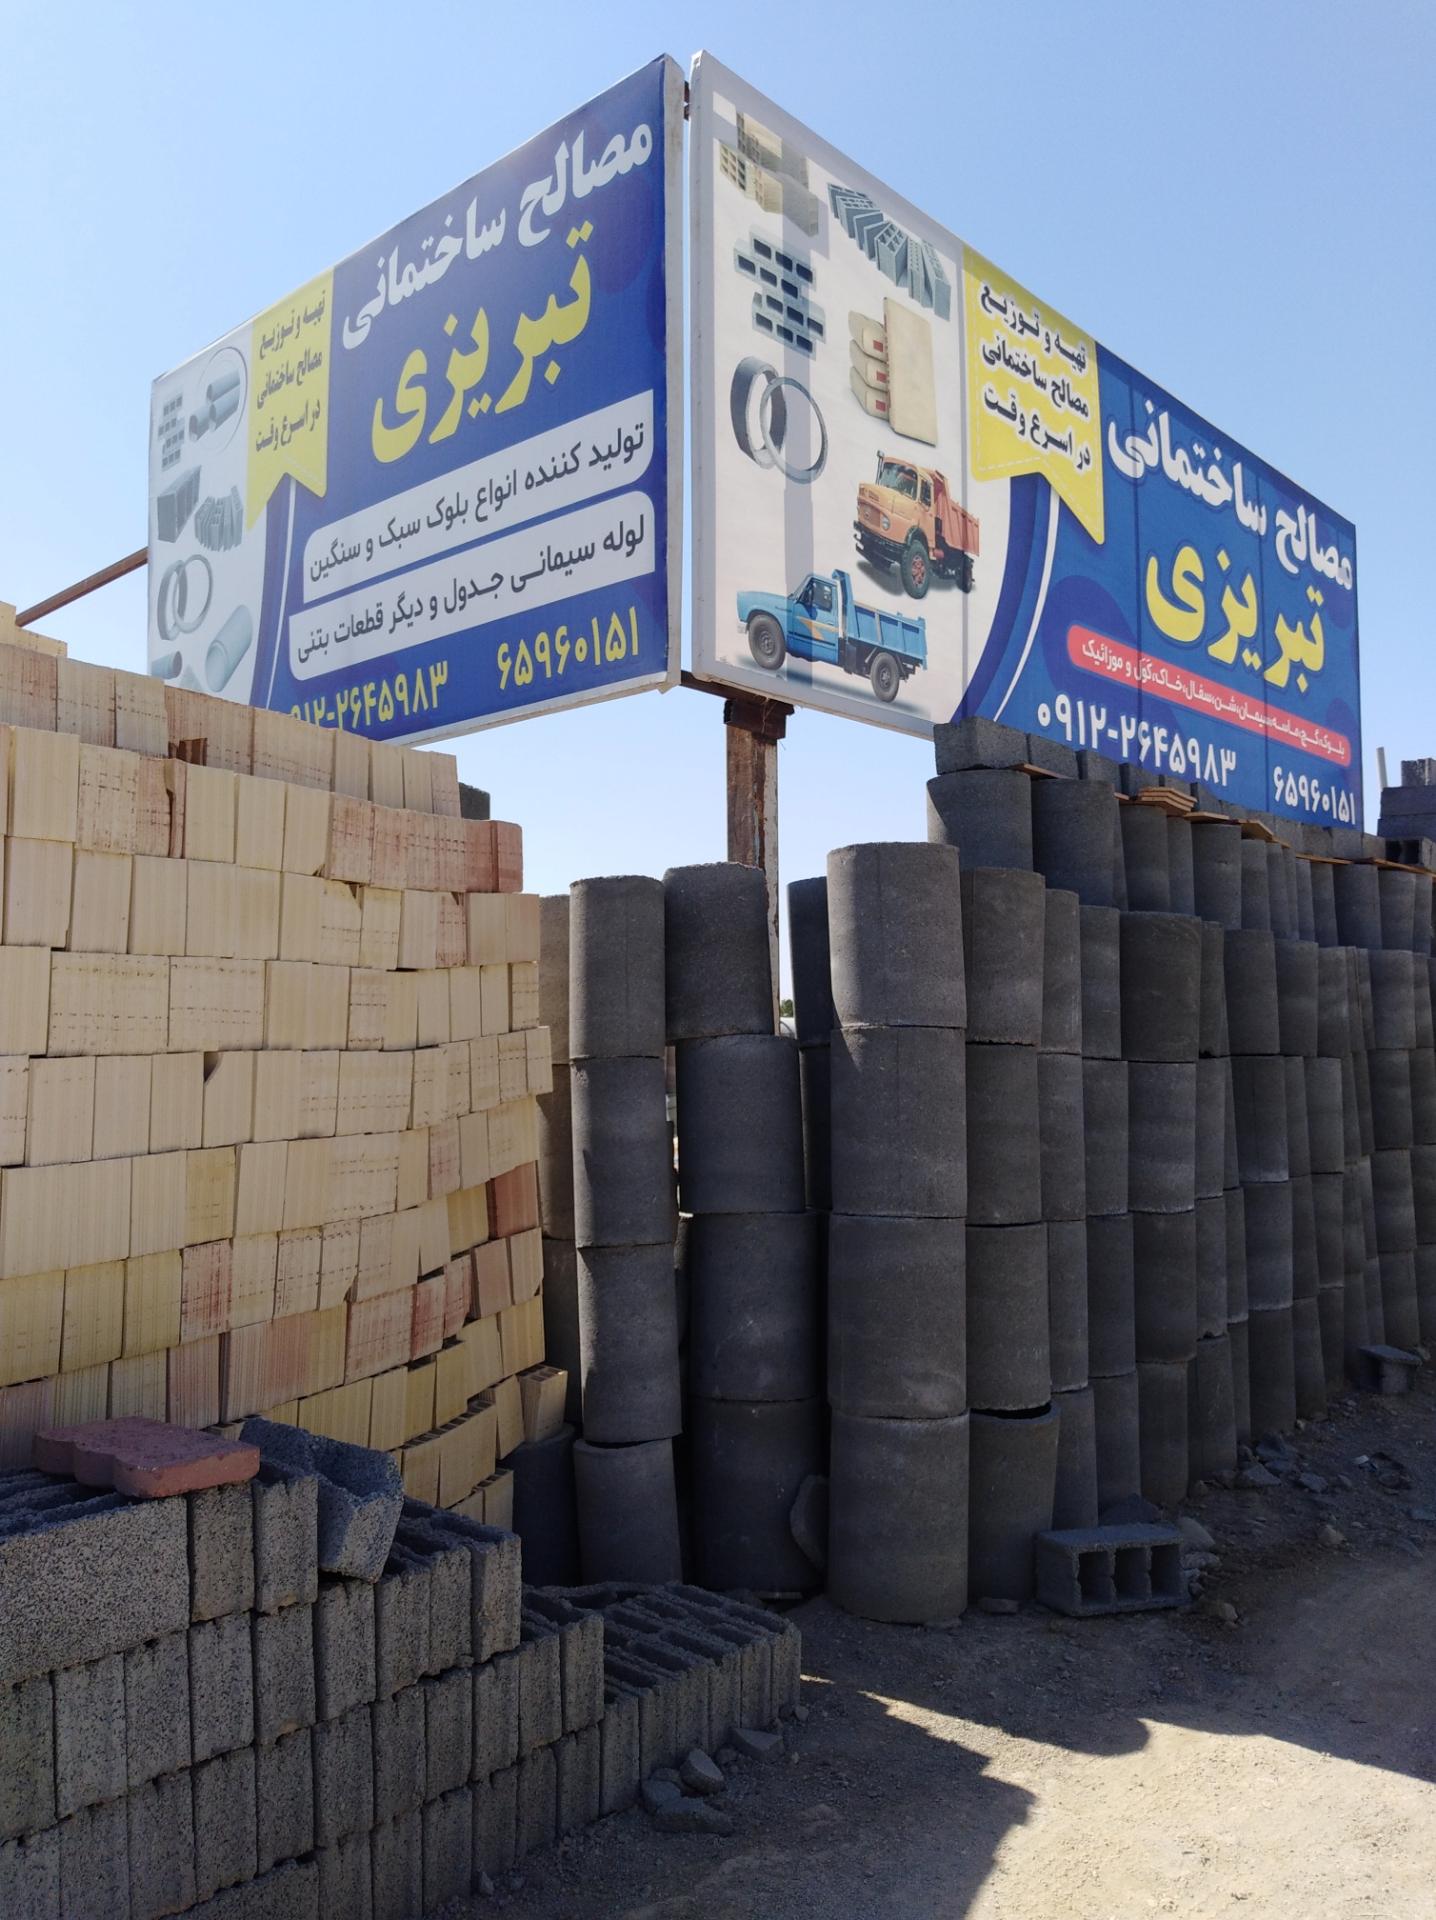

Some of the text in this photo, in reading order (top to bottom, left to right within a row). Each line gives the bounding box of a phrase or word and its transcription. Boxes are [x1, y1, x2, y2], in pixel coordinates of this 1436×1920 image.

[342, 123, 653, 350] مصالح ساختمانی
[371, 220, 594, 464] تبریزی
[980, 285, 1087, 373] تهیه و توزیع
[257, 348, 322, 409] مصالح ساختمانی
[983, 335, 1089, 418] مصالح ساختمانی
[280, 400, 309, 446] اسرع
[984, 387, 1091, 470] در اسرع وقت
[310, 422, 644, 582] تولید کننده انواع بلوک سبک و سنگین
[1107, 399, 1352, 591] مصالح ساختمانی
[297, 514, 645, 664] لوله سیمانی جدول و دیگر قطعات بتنی
[1146, 545, 1325, 693] تبریزی
[497, 605, 639, 690] ۶۵۹۶۰۱۵۱
[1125, 661, 1132, 677] و
[1037, 694, 1236, 787] ۰۹۱۲-۲۶۴۵۹۸۳
[1273, 766, 1356, 825] ۶۵۹۶۰۱۵۱
